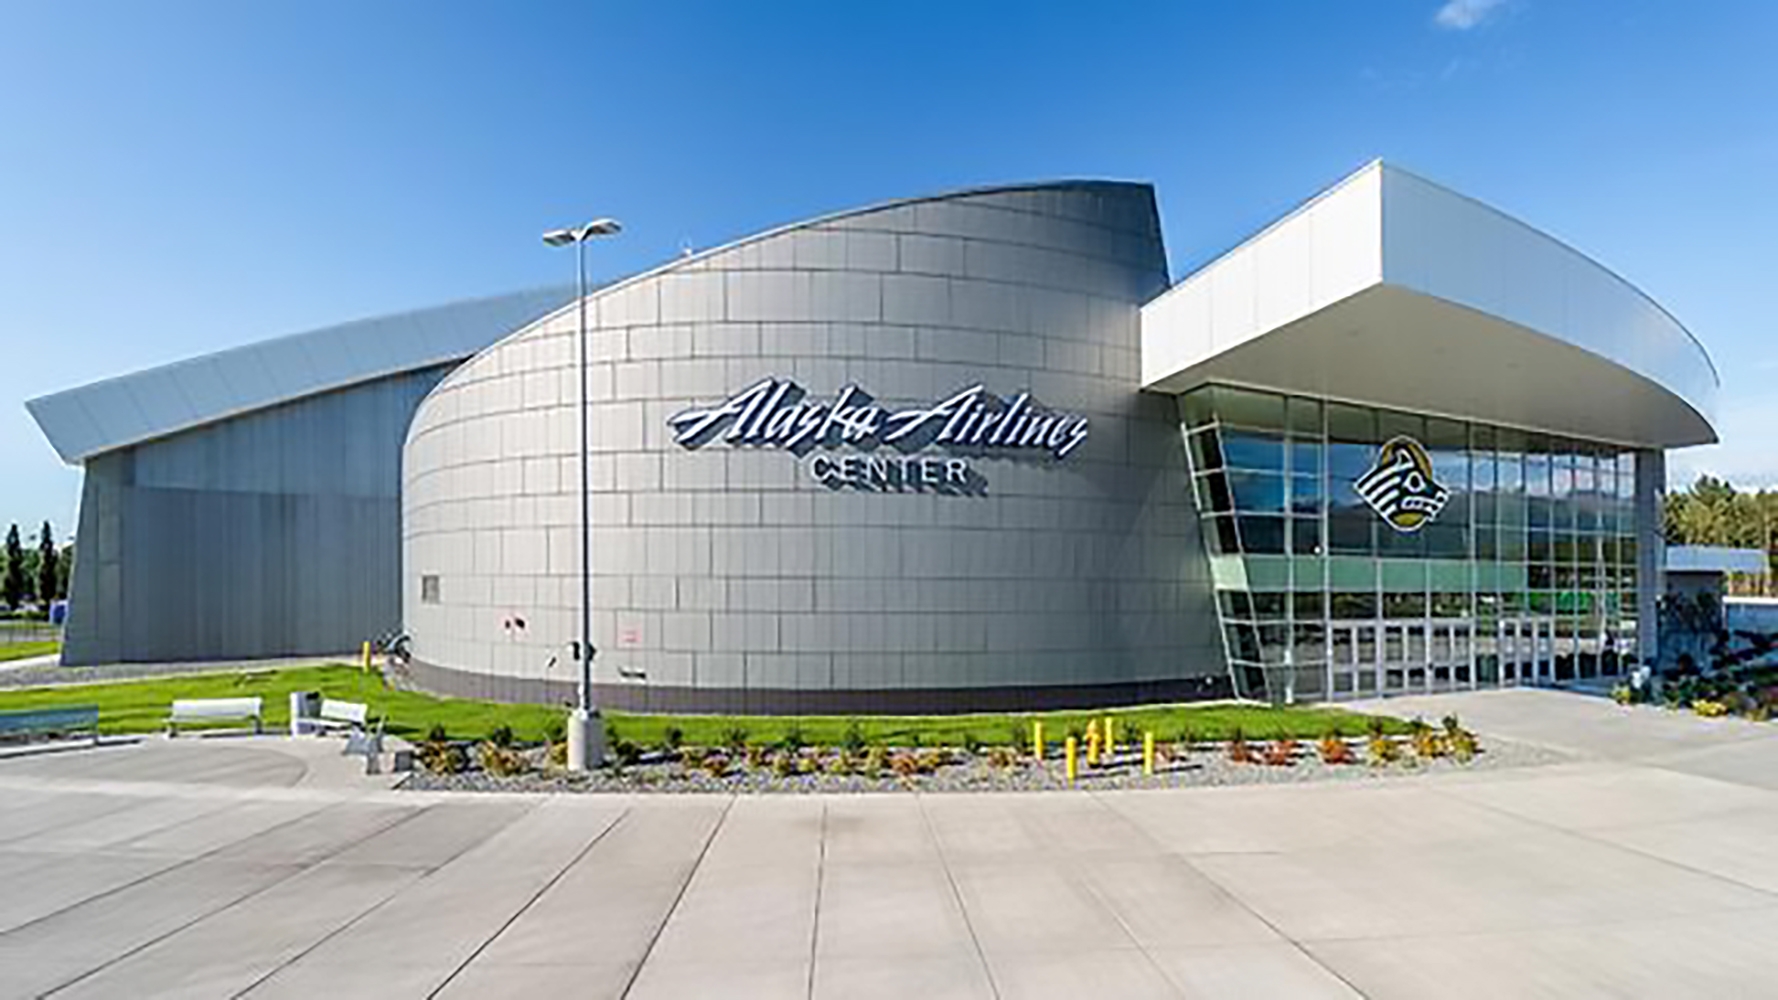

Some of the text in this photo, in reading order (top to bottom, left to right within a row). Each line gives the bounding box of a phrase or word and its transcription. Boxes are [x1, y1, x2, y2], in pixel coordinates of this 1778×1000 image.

[668, 376, 1088, 457] Alaska Airlines
[813, 455, 968, 484] CENTER
